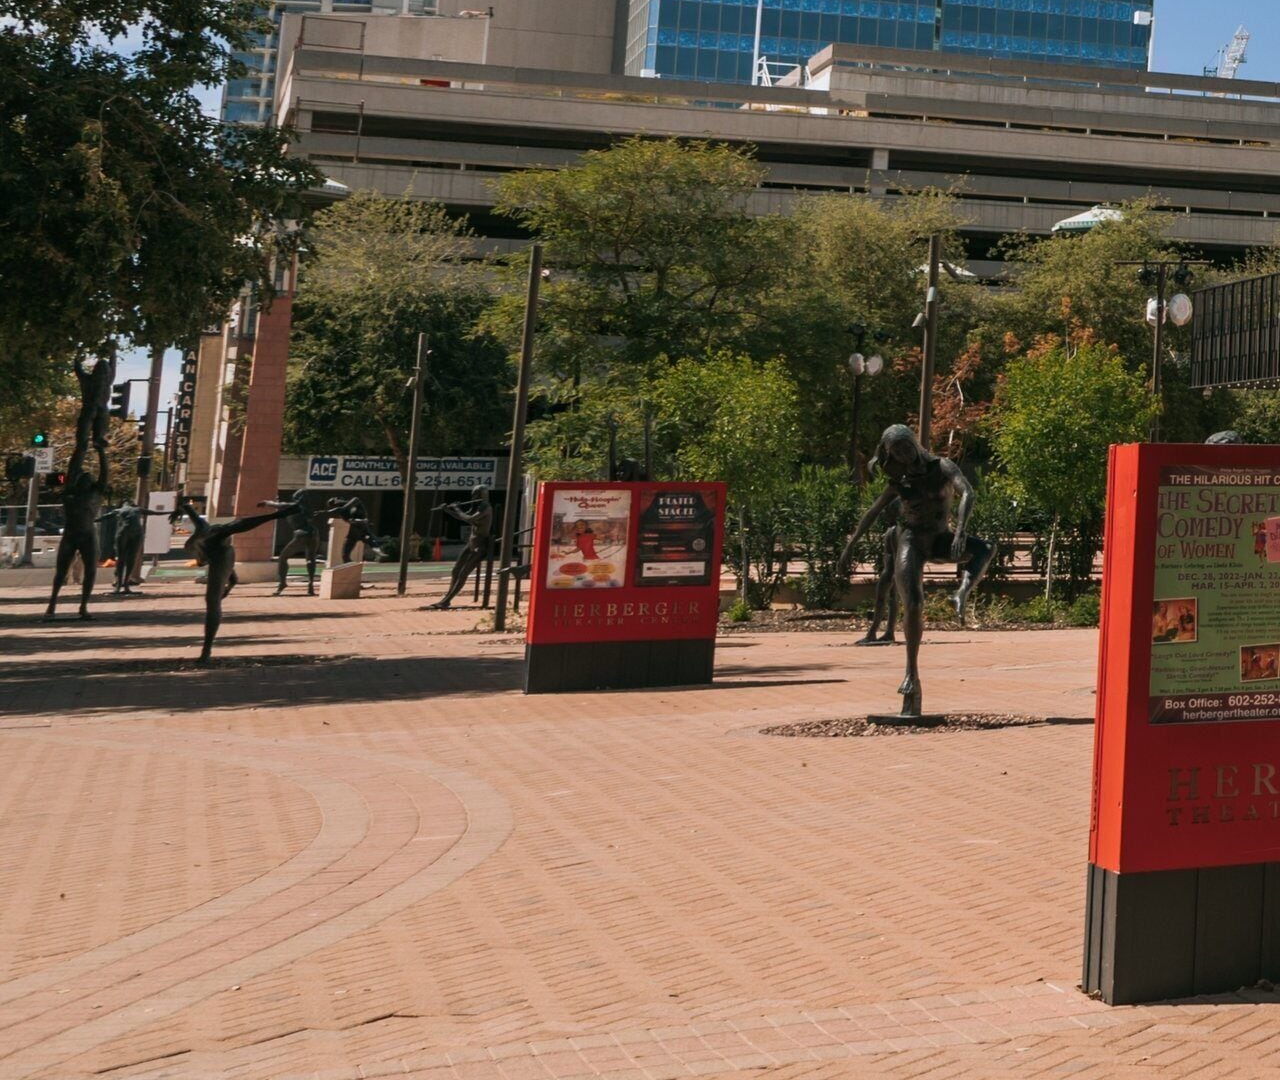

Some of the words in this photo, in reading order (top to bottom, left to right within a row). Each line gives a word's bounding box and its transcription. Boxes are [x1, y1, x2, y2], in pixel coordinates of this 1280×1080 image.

[176, 381, 193, 460] CARLOS
[311, 462, 337, 476] ACE
[345, 461, 392, 470] MONTHLY
[440, 462, 491, 470] AVAILABLE
[341, 475, 389, 487] CALL:
[1169, 474, 1192, 485] THE
[1194, 474, 1252, 485] HILARIOUS
[1254, 474, 1271, 485] HIT
[1158, 491, 1192, 511] THE
[1196, 488, 1280, 515] SECRET
[1157, 512, 1245, 540] COMEDY
[1157, 544, 1176, 559] OF
[1180, 540, 1236, 560] WOMEN
[1178, 572, 1200, 581] DEC.
[1191, 582, 1217, 590] MAR.
[553, 601, 700, 618] HERBERGER
[1165, 699, 1185, 709] Box
[1188, 697, 1223, 709] Office:
